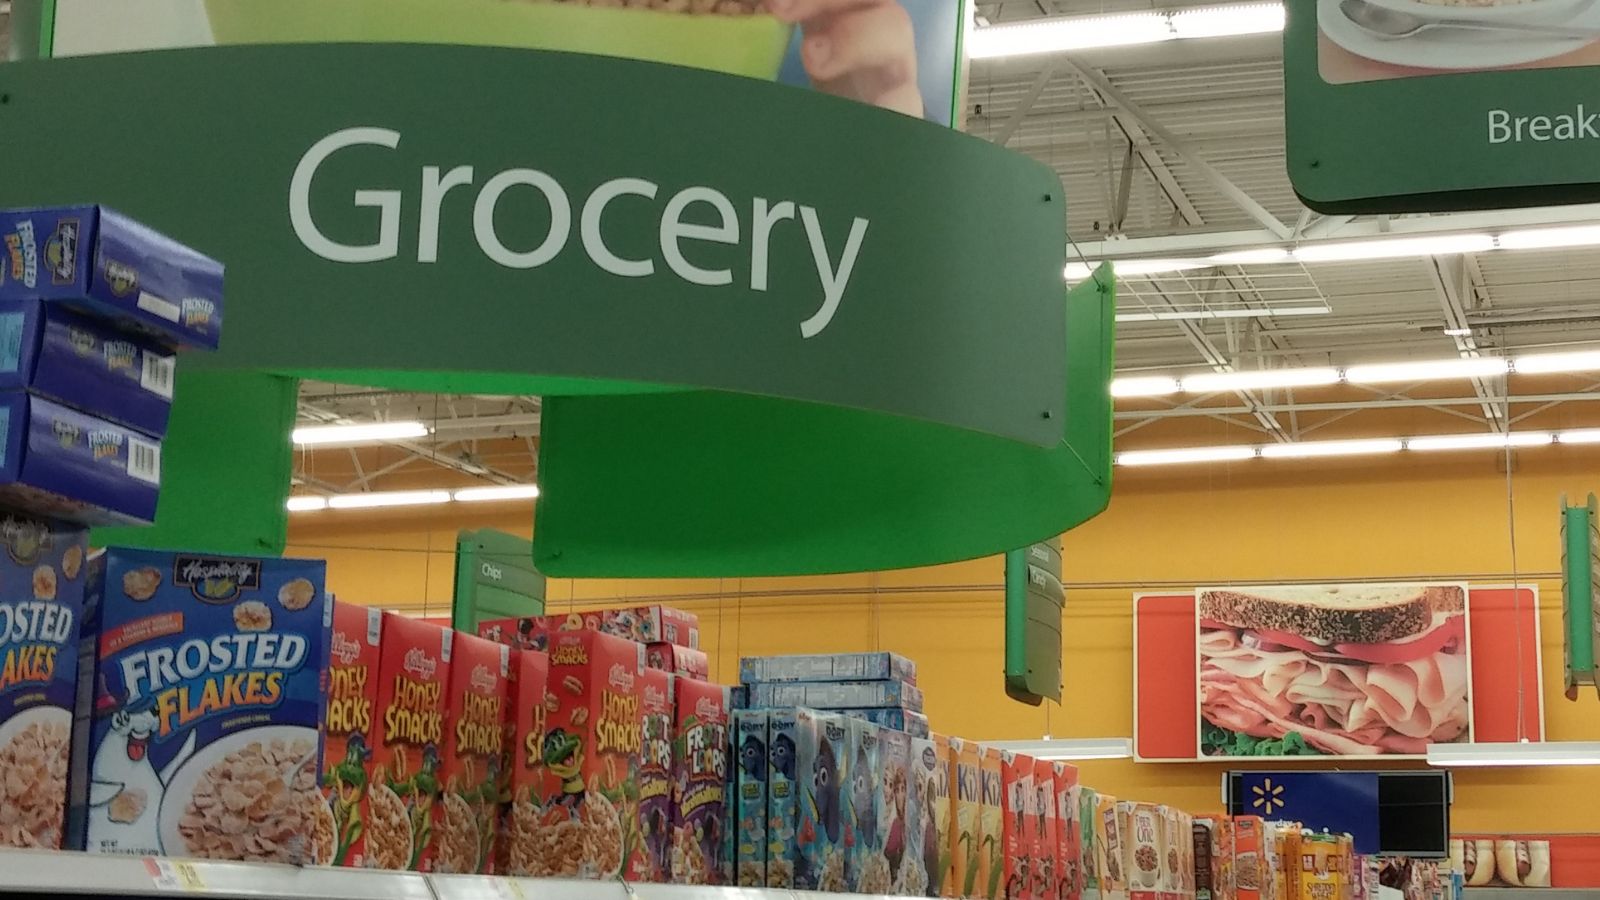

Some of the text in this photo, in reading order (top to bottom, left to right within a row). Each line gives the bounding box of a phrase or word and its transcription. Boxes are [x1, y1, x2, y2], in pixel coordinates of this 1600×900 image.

[1488, 104, 1600, 143] Break
[289, 126, 869, 338] Grocery
[481, 562, 502, 581] Chips
[0, 601, 73, 648] OSTED
[0, 645, 57, 690] AKES
[120, 632, 307, 705] FROSTED
[156, 671, 284, 737] FLAKES
[326, 697, 371, 734] ACKS
[642, 713, 671, 741] ROOT
